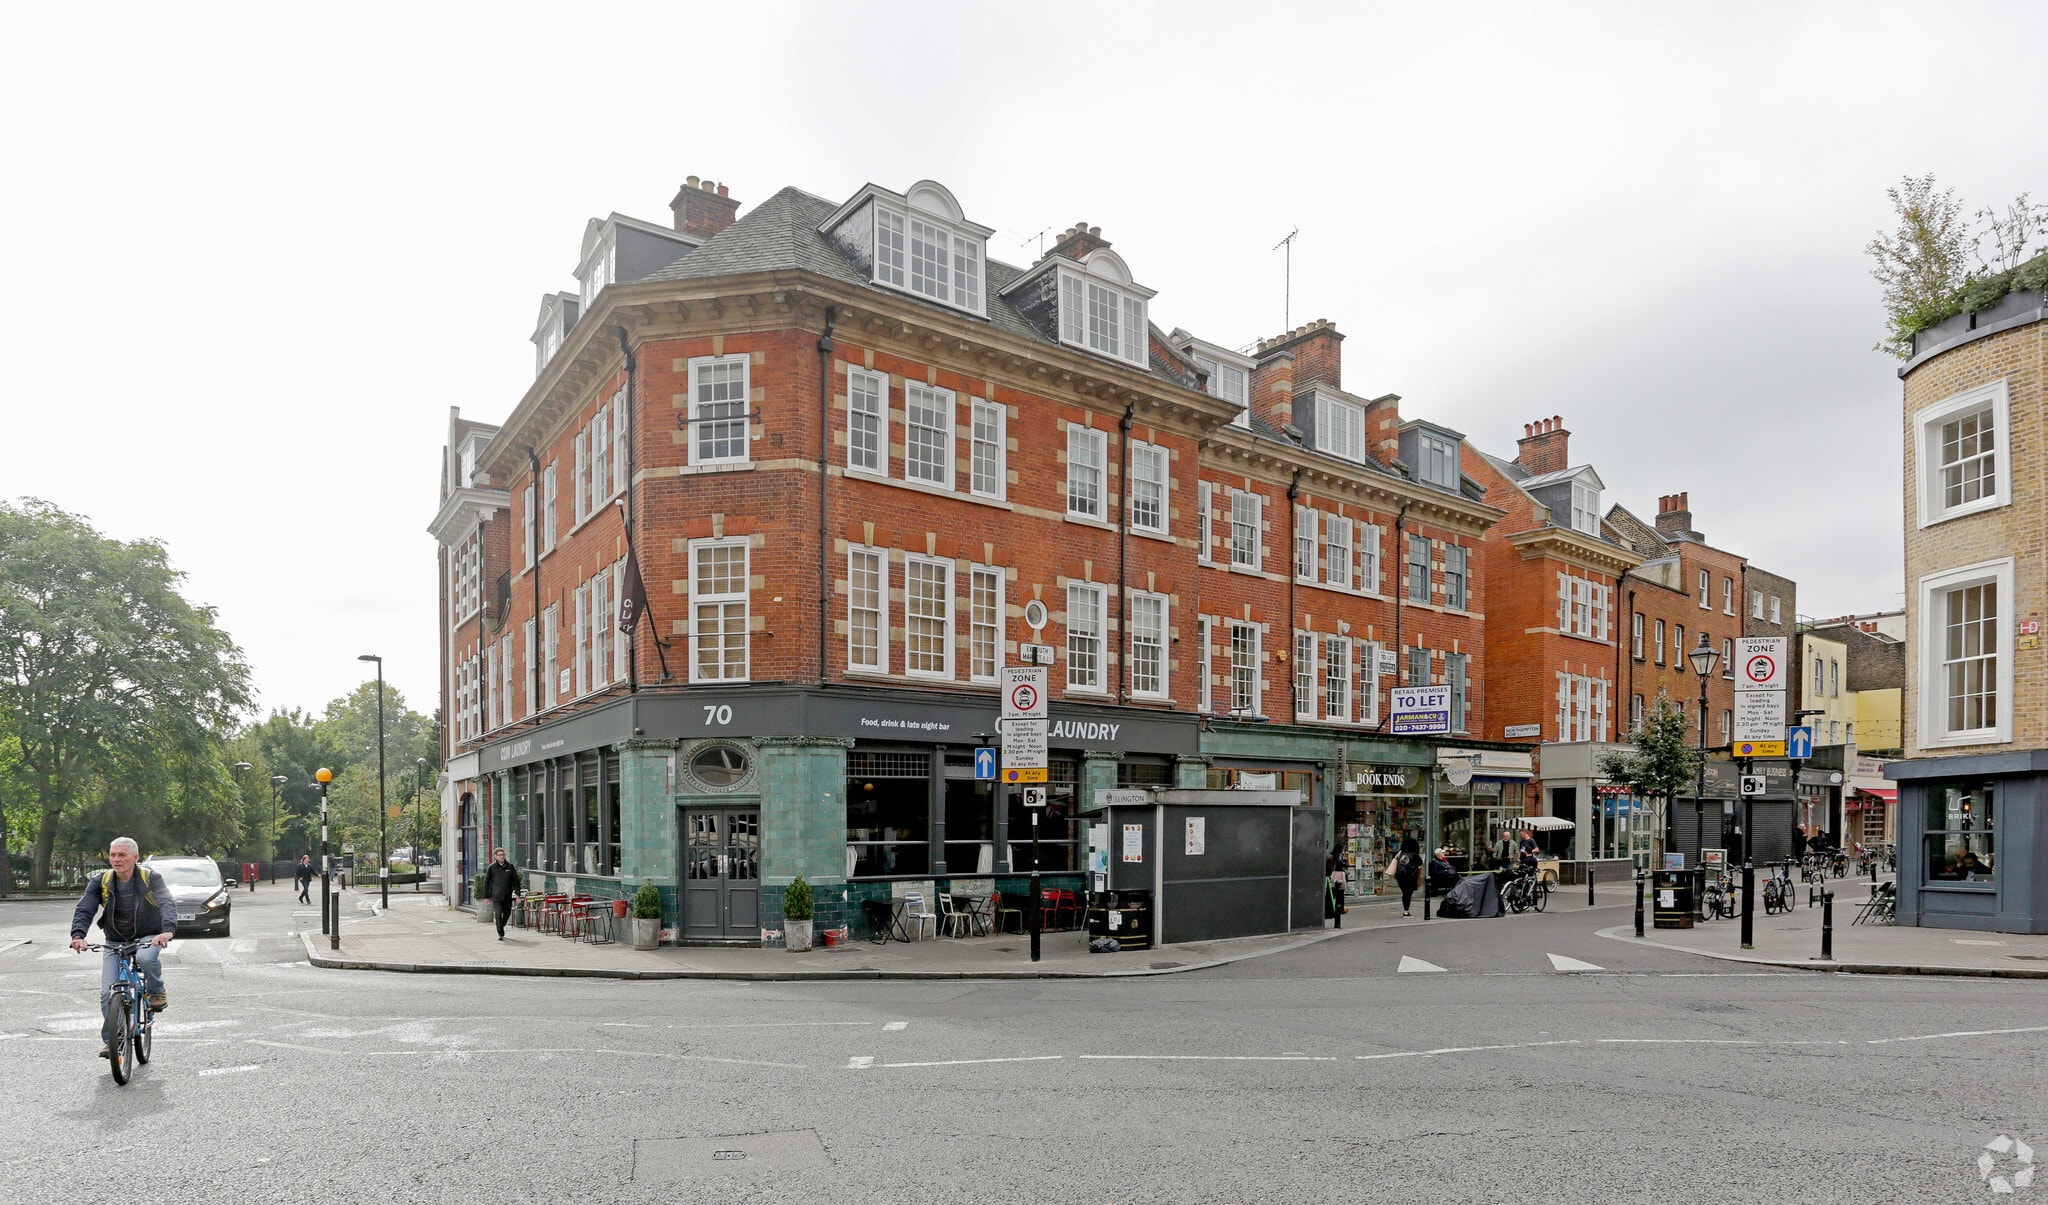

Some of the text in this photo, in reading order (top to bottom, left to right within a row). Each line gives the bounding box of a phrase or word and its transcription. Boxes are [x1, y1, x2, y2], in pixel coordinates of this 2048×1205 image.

[1397, 694, 1445, 708] TO LET
[704, 704, 732, 725] 70
[861, 718, 880, 727] Food,
[881, 720, 898, 728] drink
[907, 720, 920, 728] late
[921, 722, 938, 730] night
[1048, 720, 1120, 740] LAUNDRY
[1356, 773, 1405, 786] BOOK ENDS
